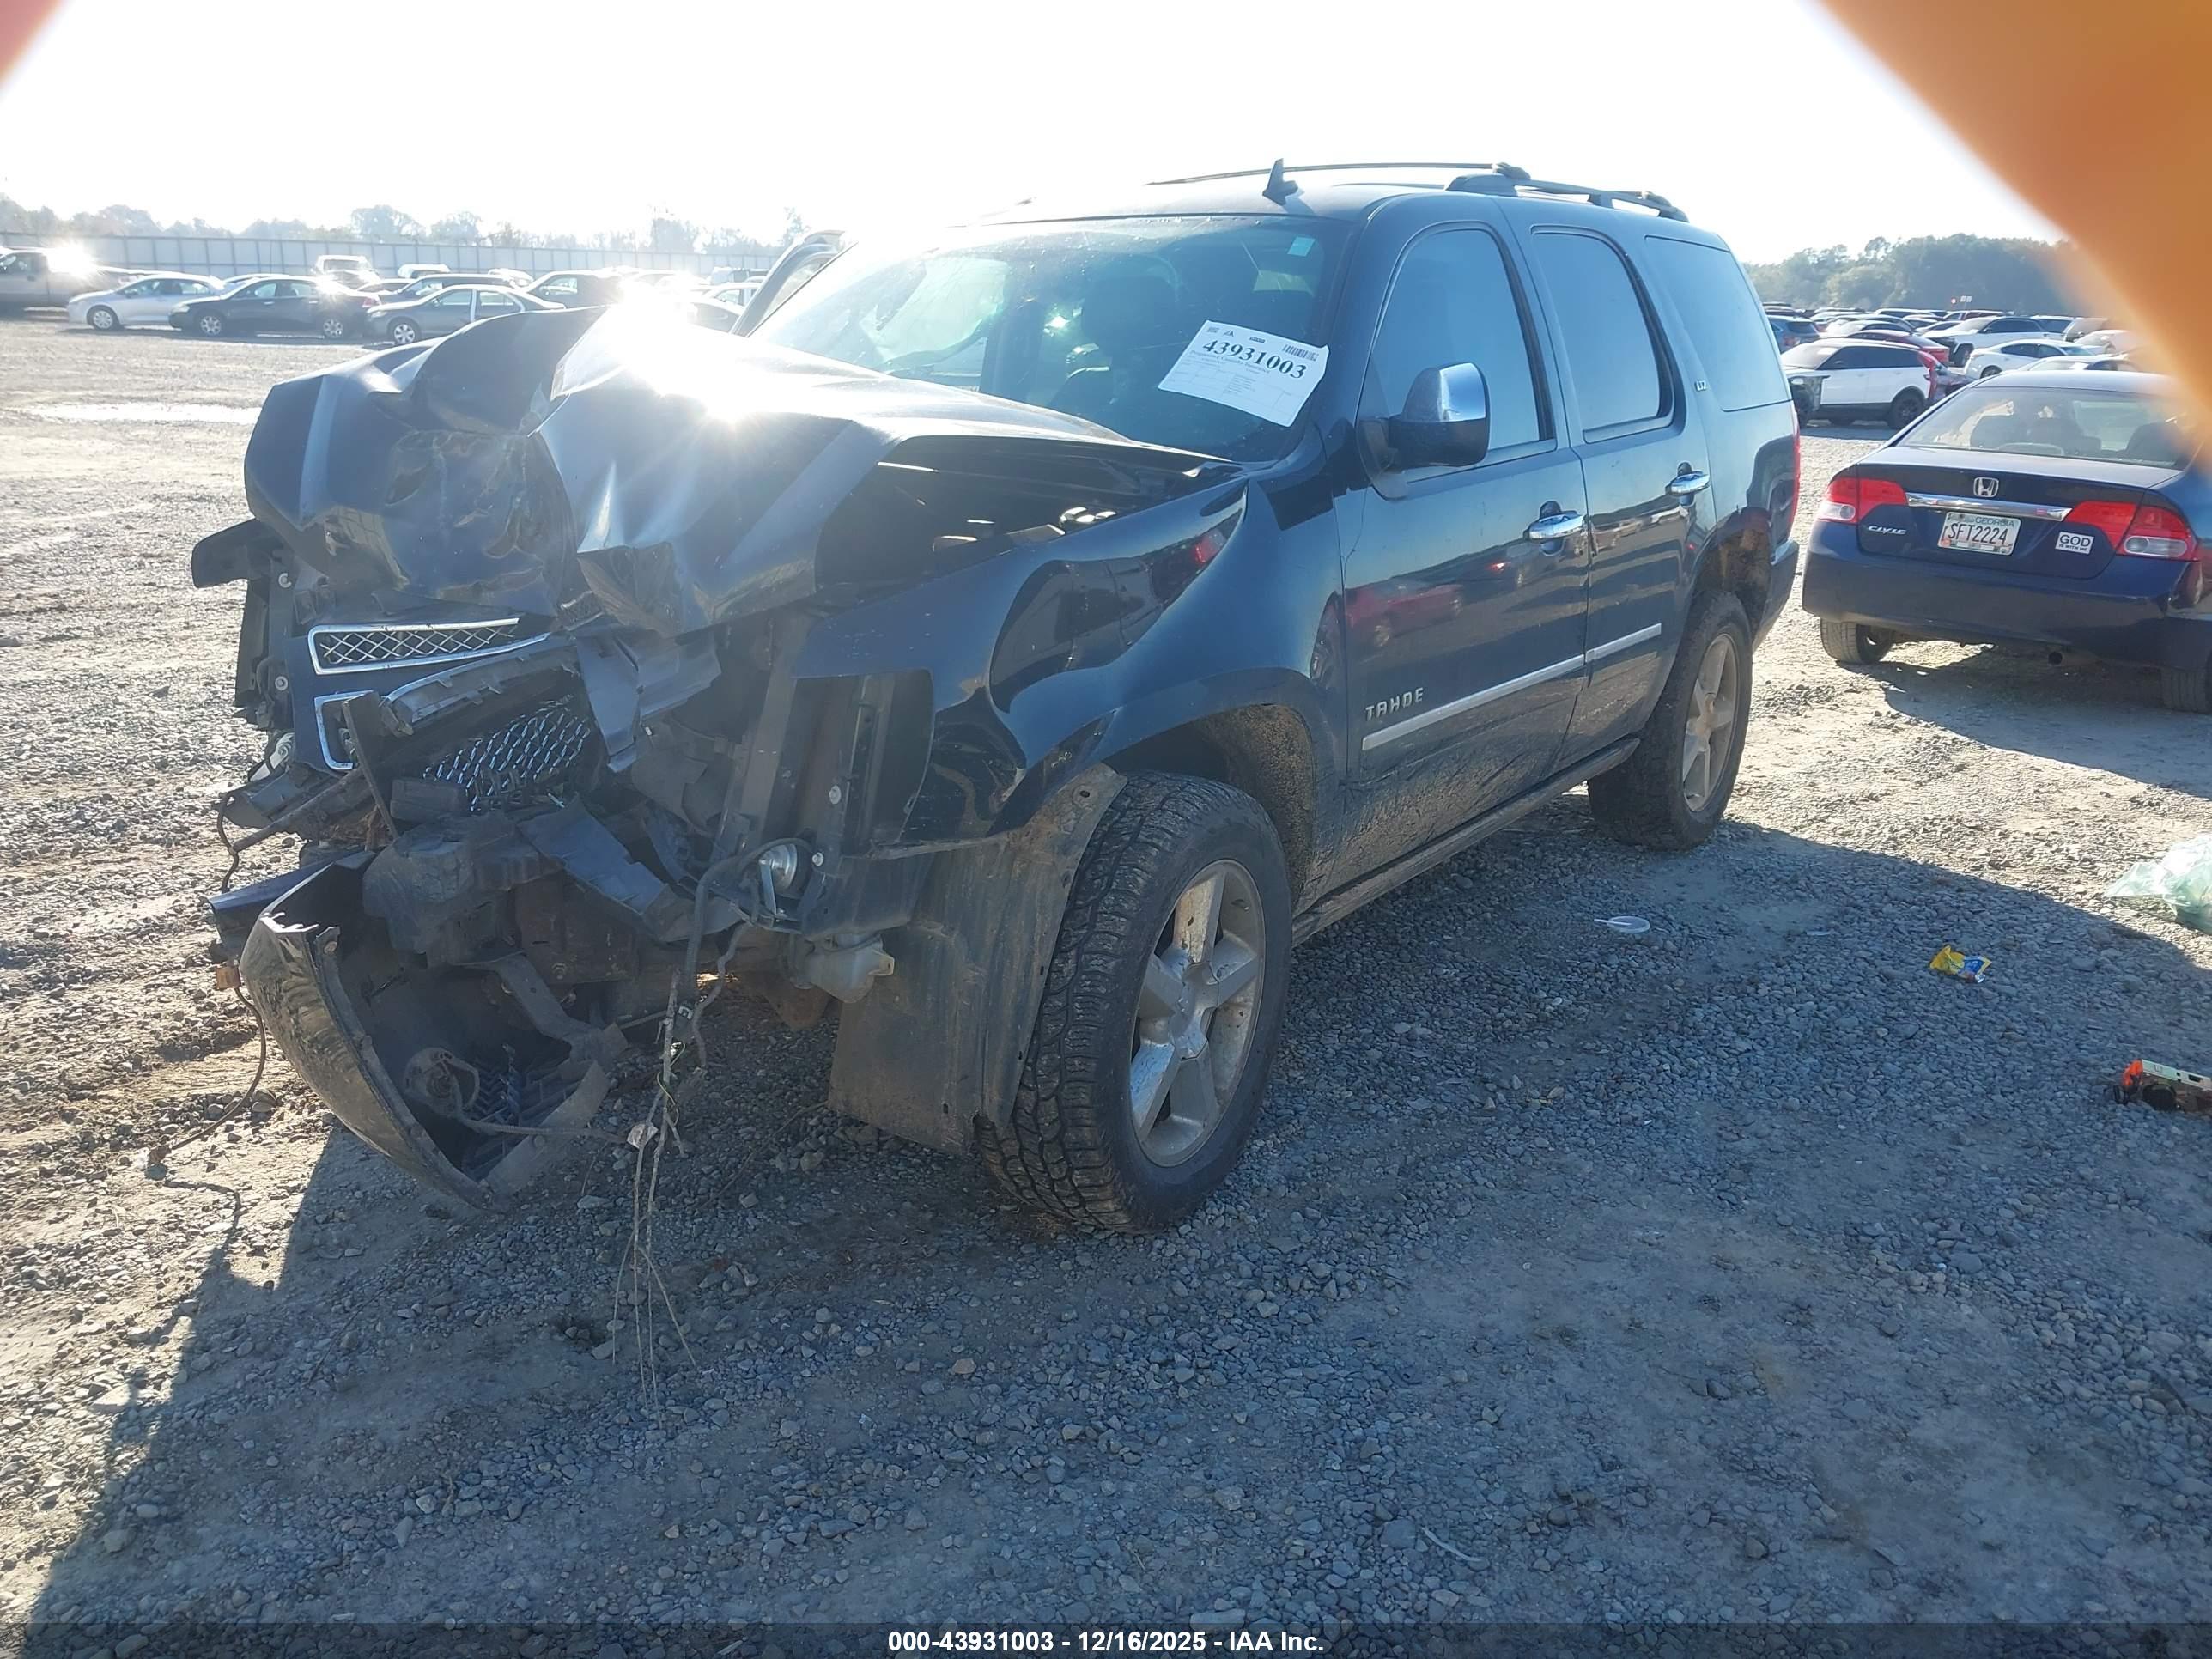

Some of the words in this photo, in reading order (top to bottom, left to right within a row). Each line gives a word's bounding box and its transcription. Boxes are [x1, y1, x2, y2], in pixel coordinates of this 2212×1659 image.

[1203, 340, 1306, 379] 43931003
[1975, 516, 2014, 527] GEORGIA
[1948, 522, 2008, 545] SFT2224
[2059, 534, 2091, 547] GOD
[1365, 687, 1424, 720] TAHOE
